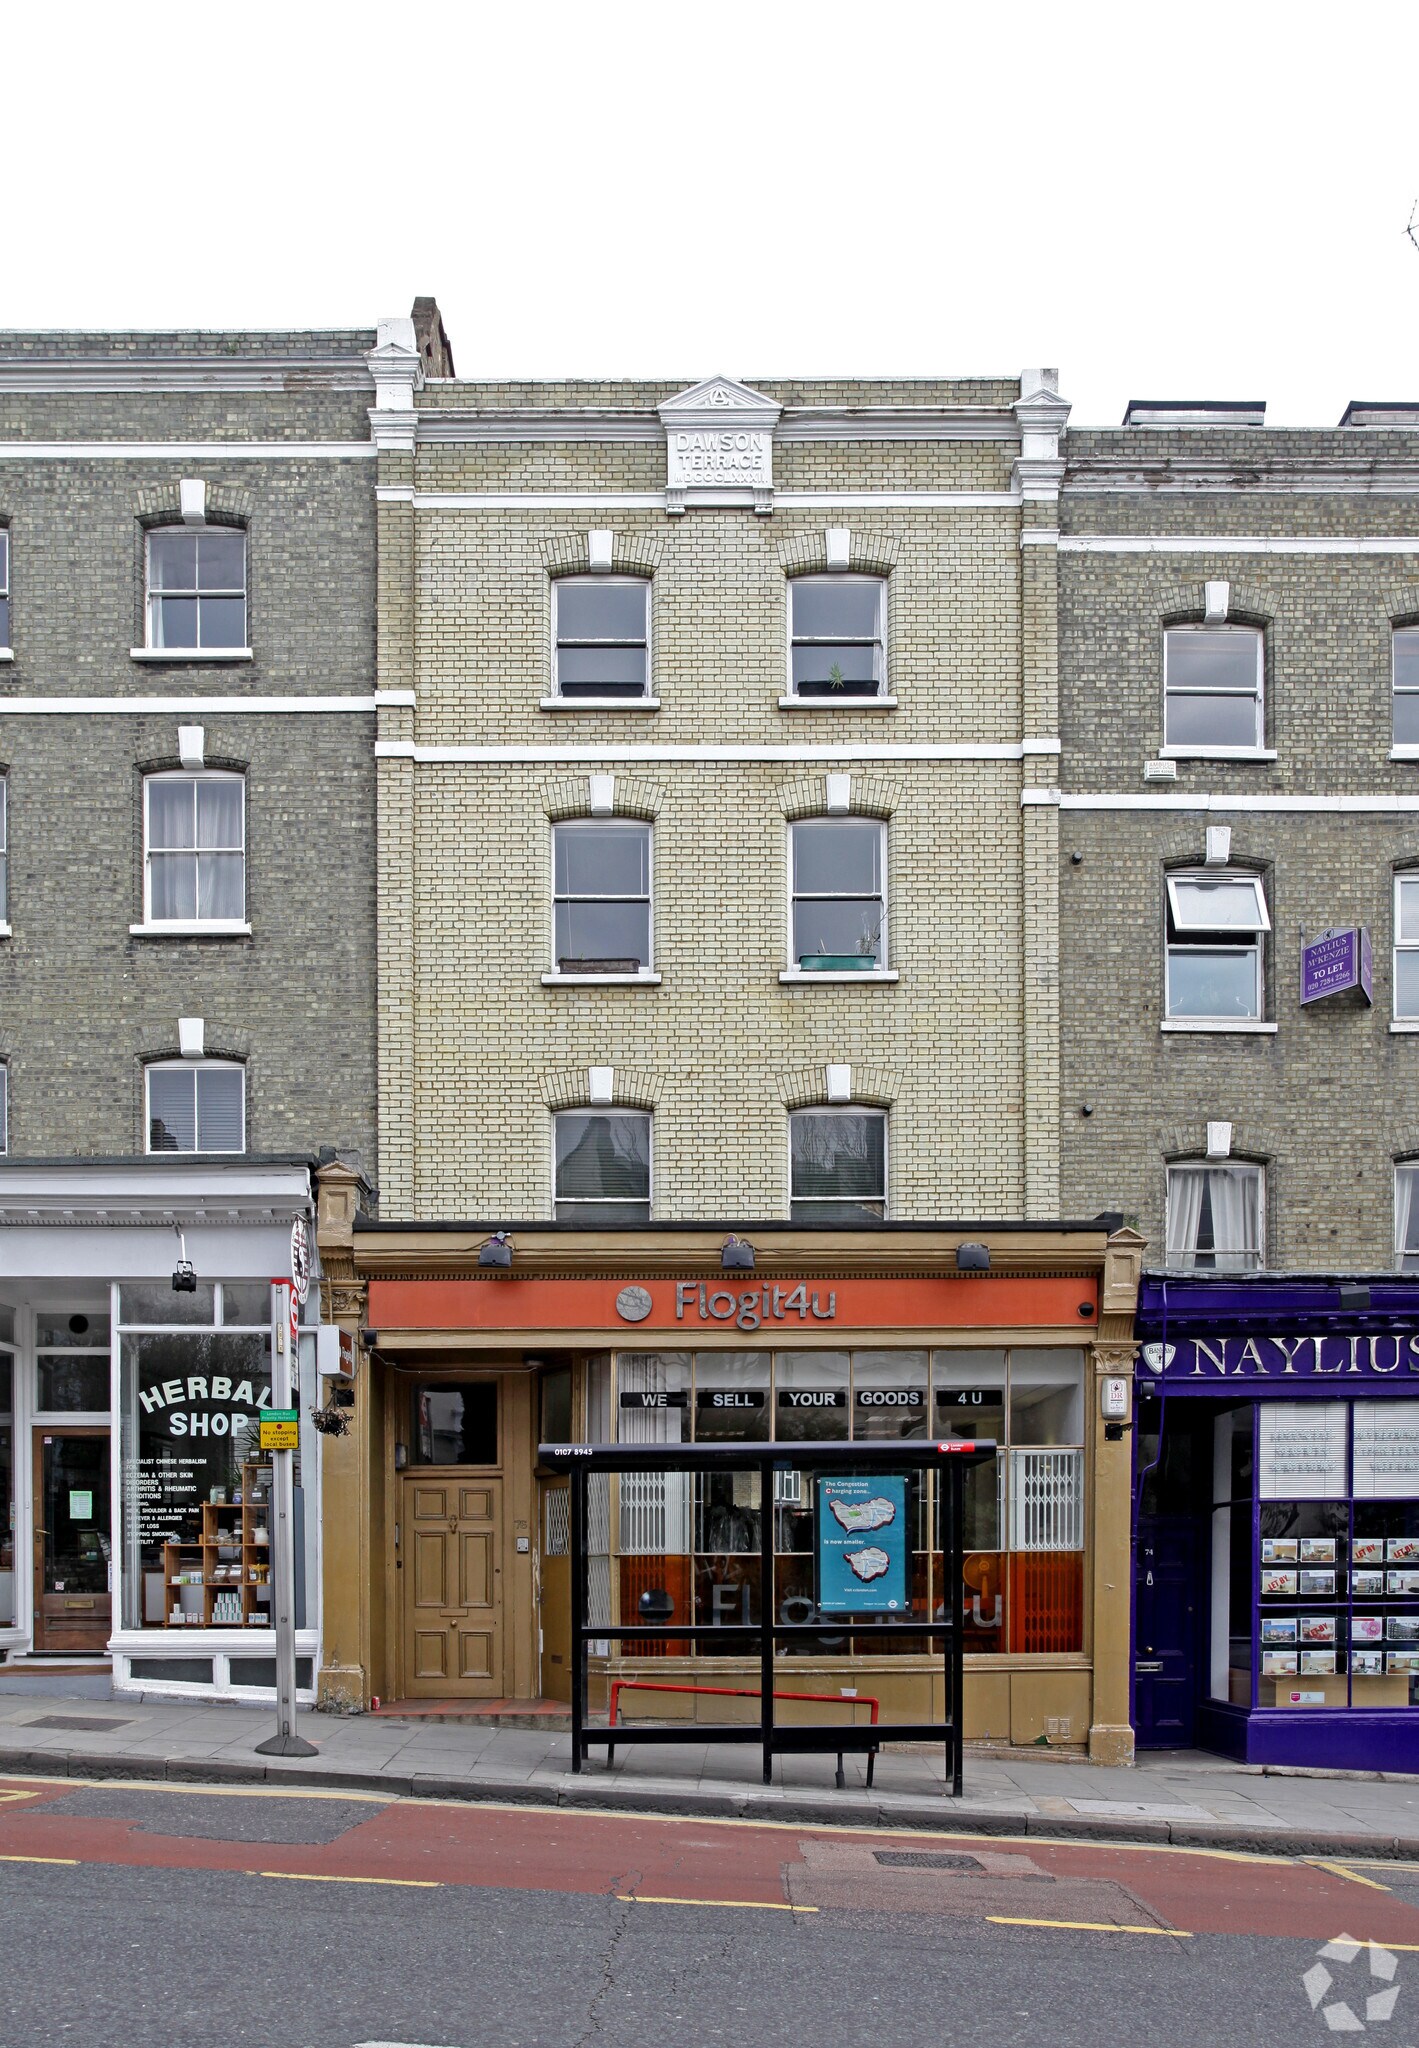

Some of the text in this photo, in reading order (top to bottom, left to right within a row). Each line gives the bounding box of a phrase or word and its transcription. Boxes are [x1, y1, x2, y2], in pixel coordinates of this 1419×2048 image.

[677, 433, 763, 452] DAWSON
[1310, 936, 1347, 957] NAYLIUS
[1313, 962, 1344, 979] TO LET
[1307, 982, 1319, 991] 020
[676, 1281, 836, 1331] Flogit4u
[138, 1376, 273, 1414] HERBAL
[641, 1391, 982, 1407] WE SELL YOUR GOODS 4 U
[169, 1412, 249, 1437] SHOP
[554, 1448, 593, 1456] 0107 8945
[1144, 1548, 1154, 1556] 74
[1355, 1548, 1366, 1559] LET
[1267, 1579, 1279, 1591] LET
